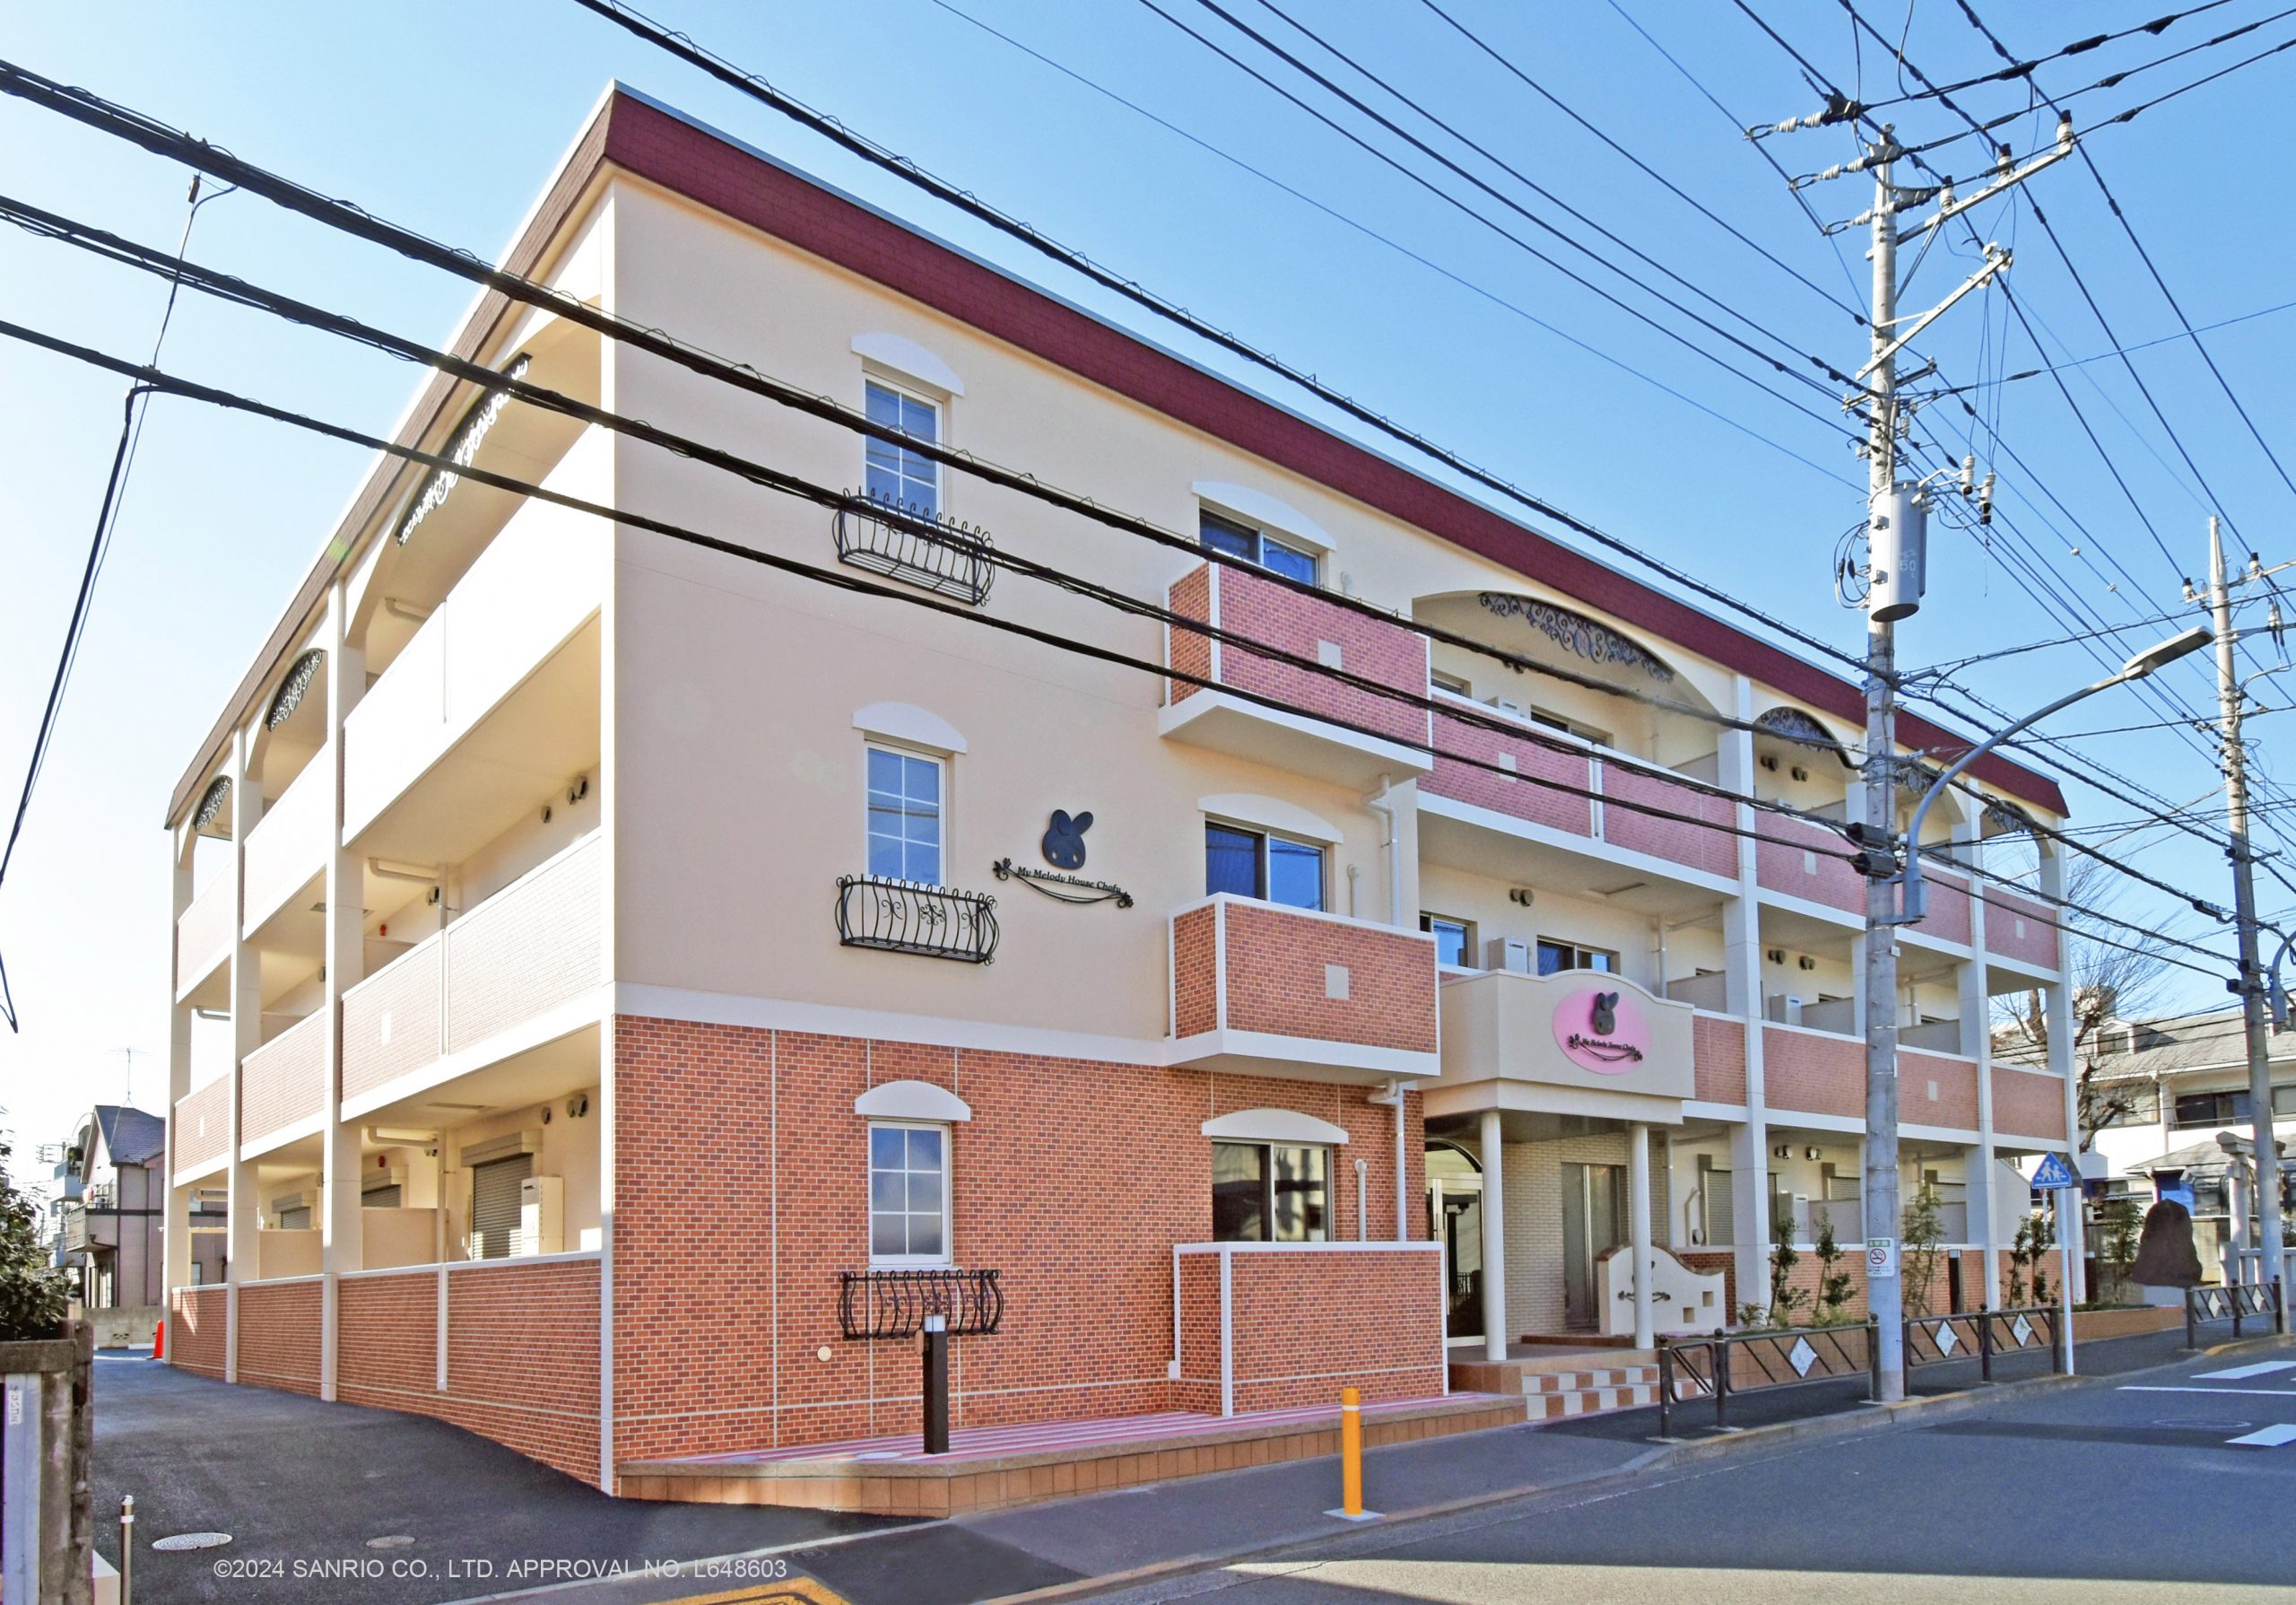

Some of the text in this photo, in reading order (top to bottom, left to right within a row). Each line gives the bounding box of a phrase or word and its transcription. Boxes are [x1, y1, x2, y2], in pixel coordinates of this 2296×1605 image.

[1017, 867, 1121, 893] My Melody House Chofu
